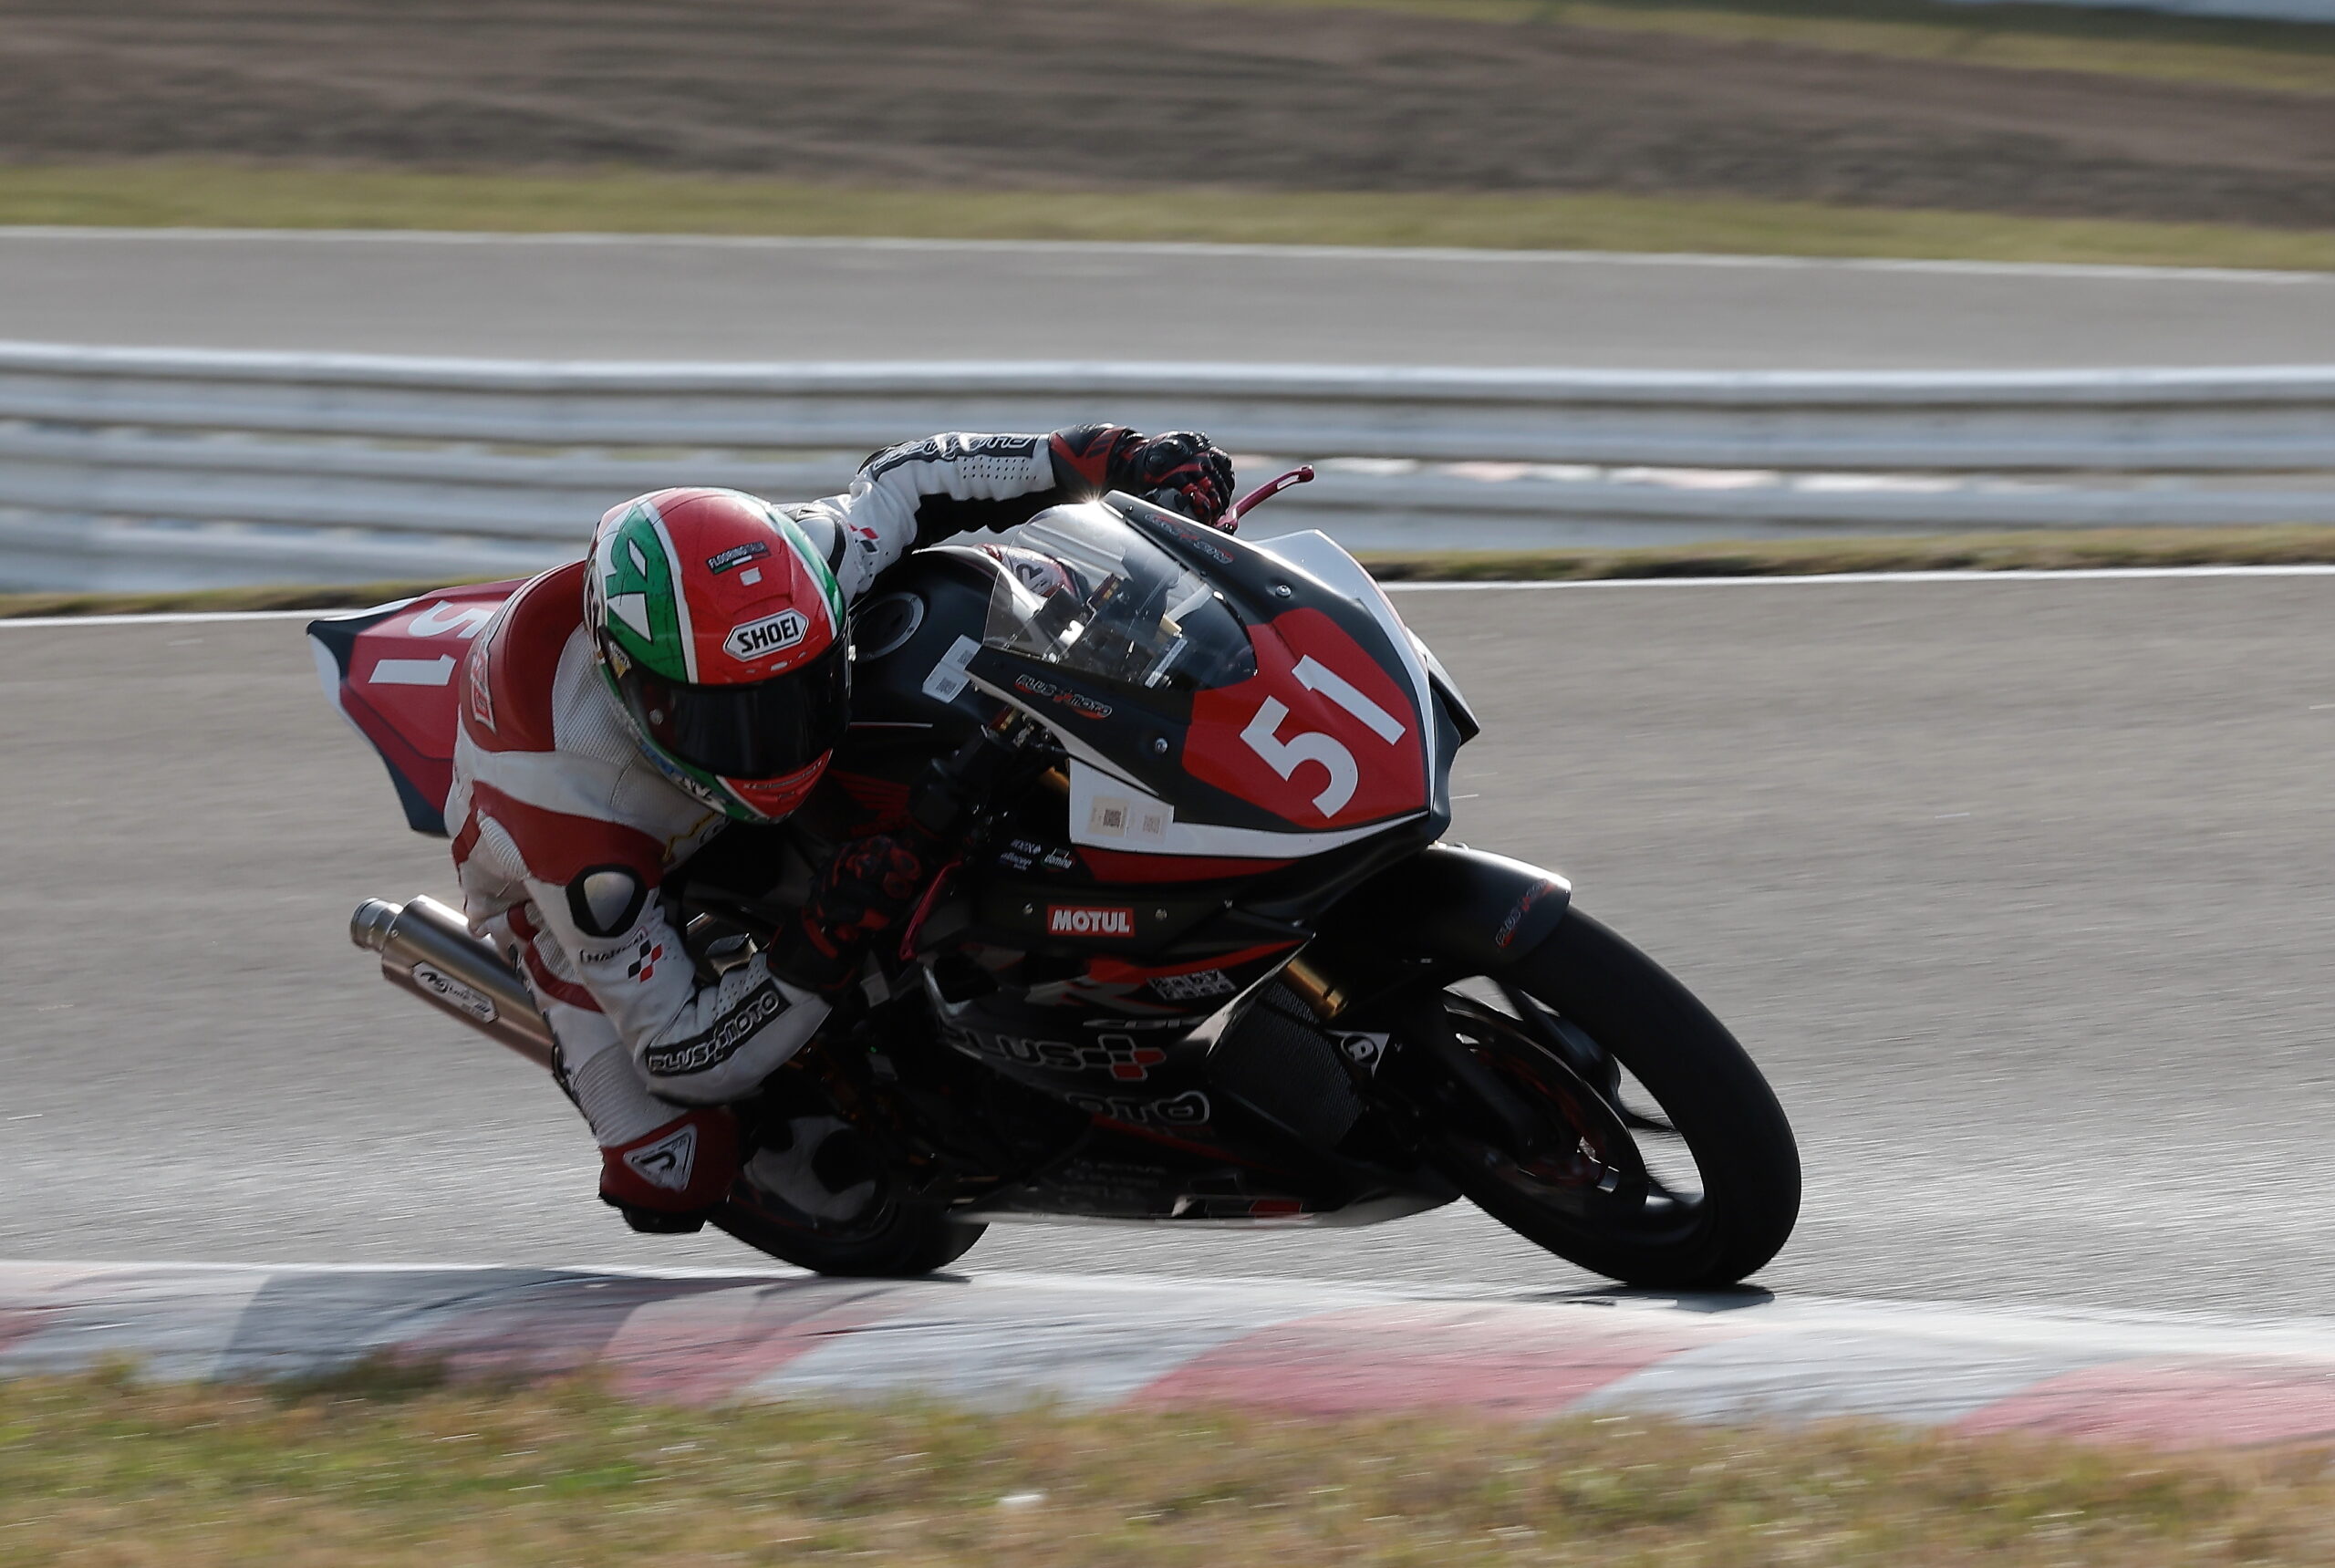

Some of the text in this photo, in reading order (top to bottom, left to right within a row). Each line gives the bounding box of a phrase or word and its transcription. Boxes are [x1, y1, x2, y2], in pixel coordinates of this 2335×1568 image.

[368, 600, 496, 686] 51
[737, 616, 799, 654] SHOEI
[1240, 654, 1406, 818] 51
[1052, 909, 1130, 932] MOTUL
[649, 991, 779, 1072] PLUS MOTO
